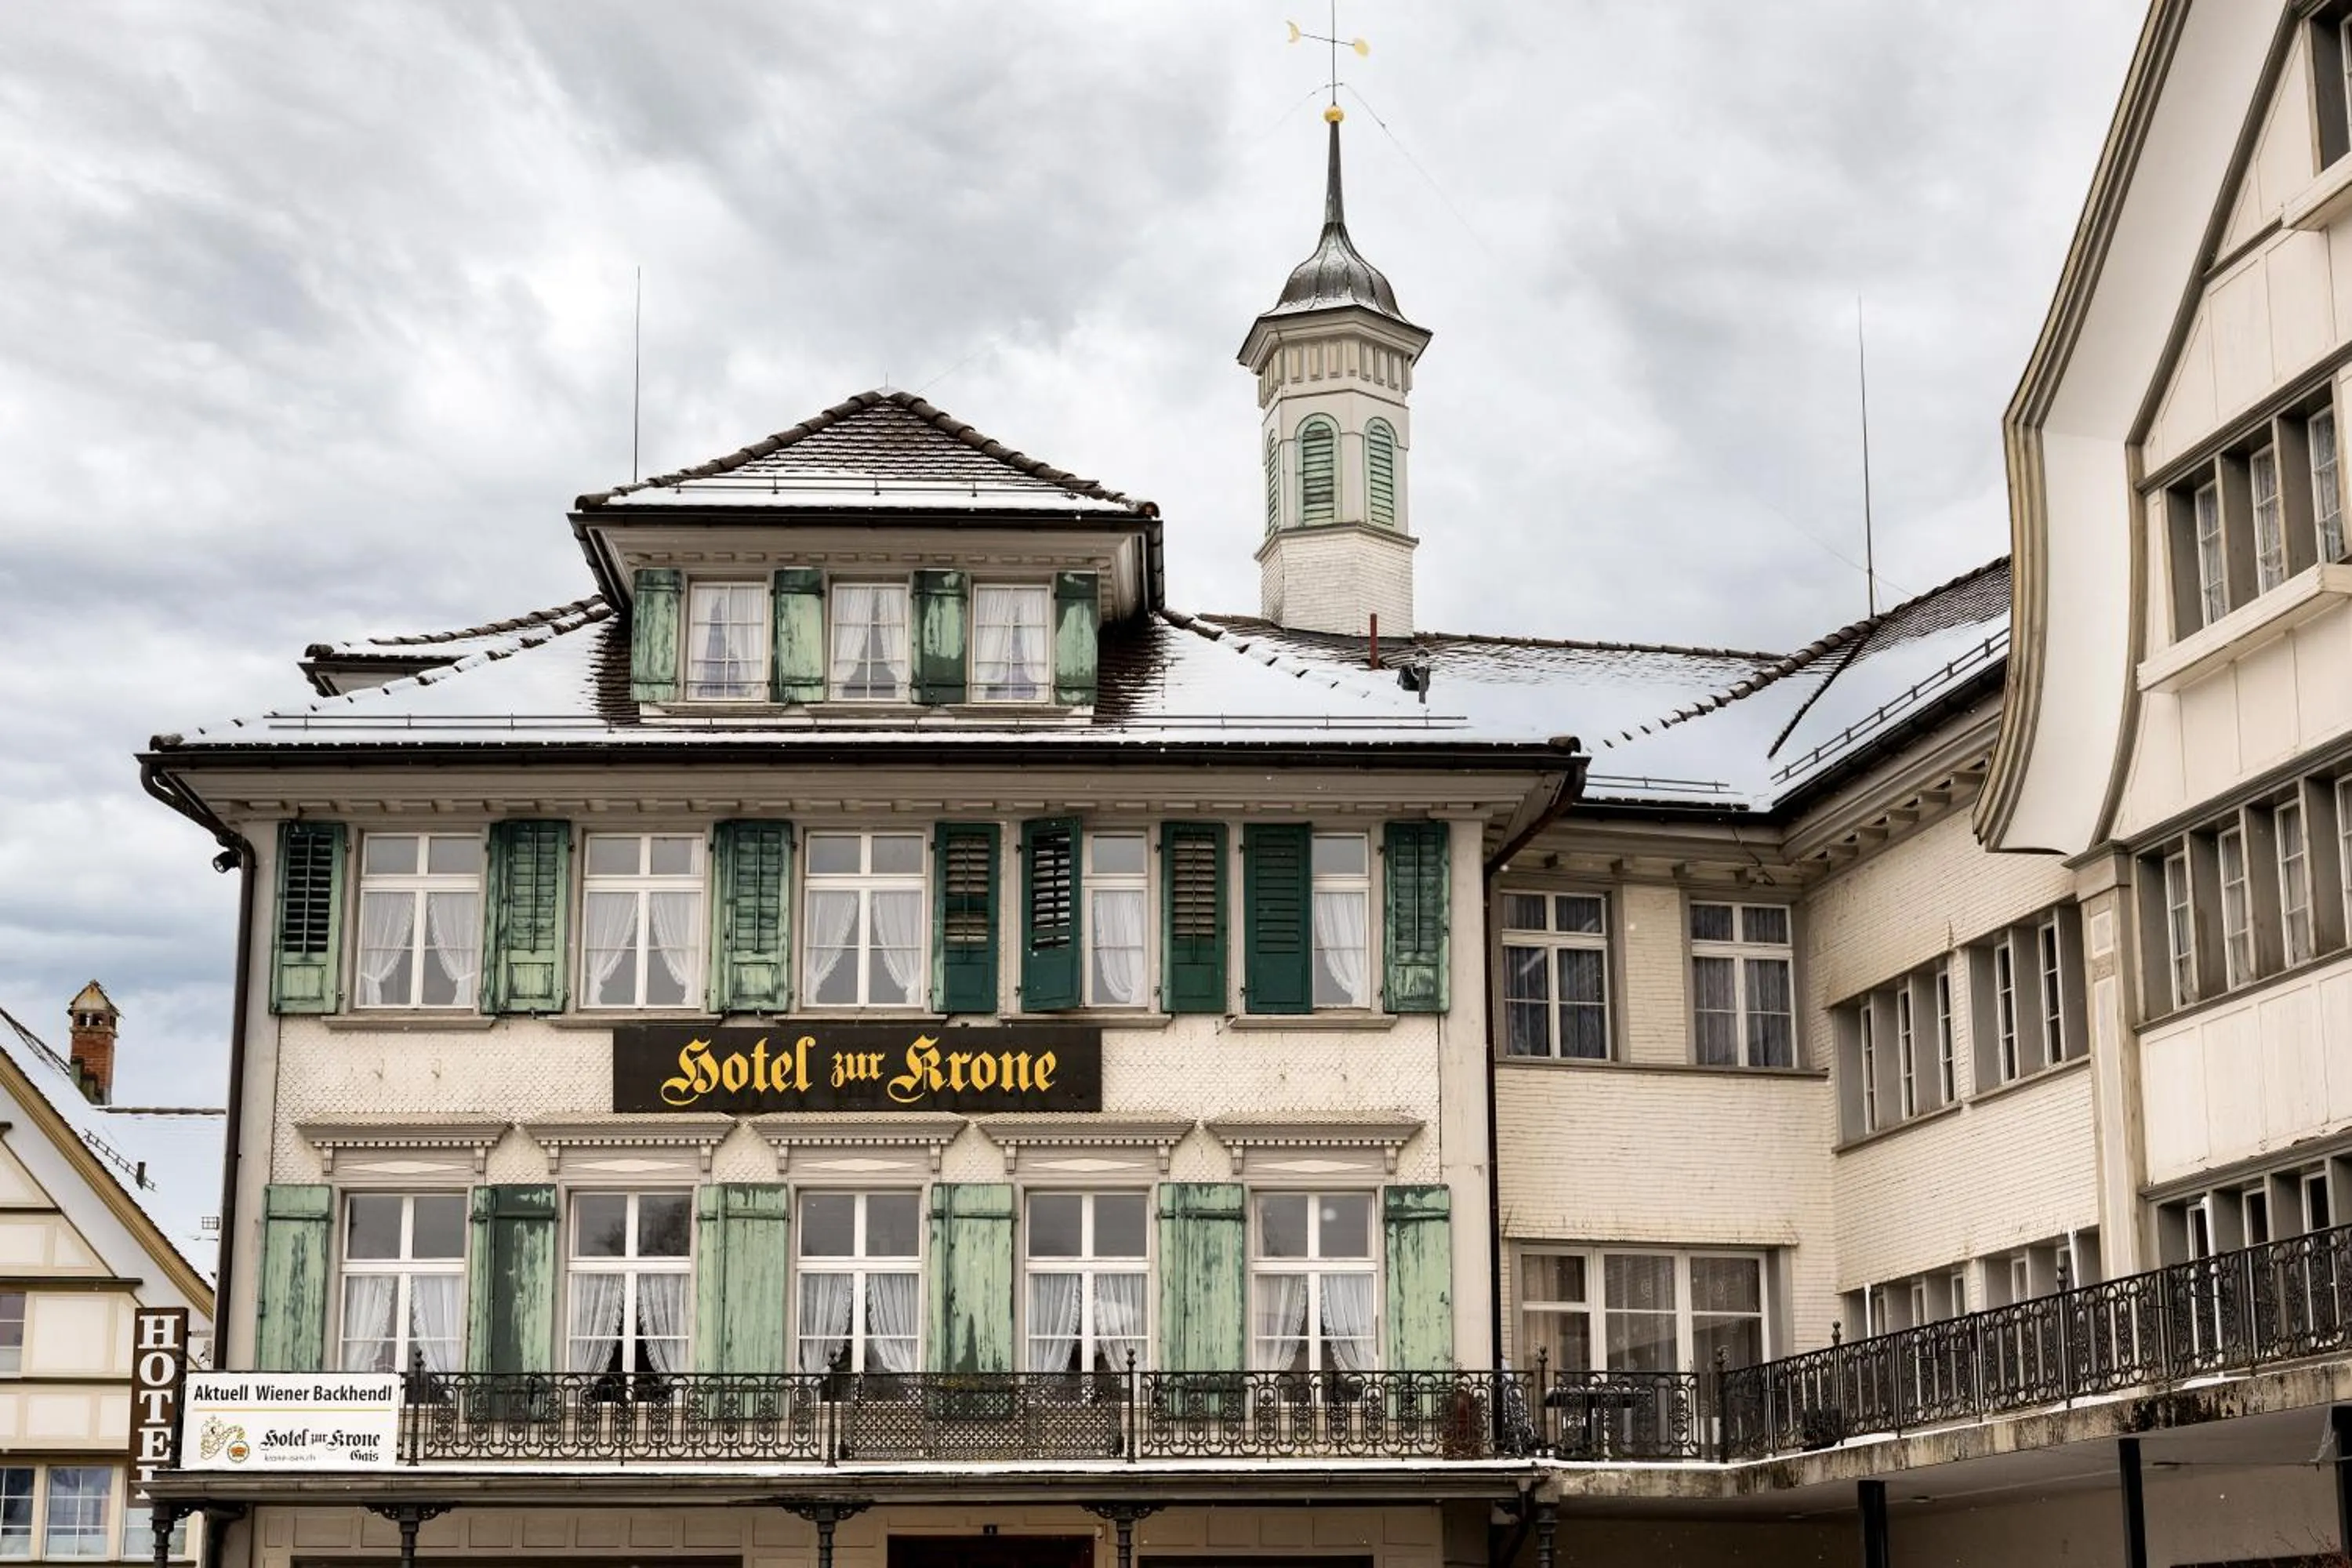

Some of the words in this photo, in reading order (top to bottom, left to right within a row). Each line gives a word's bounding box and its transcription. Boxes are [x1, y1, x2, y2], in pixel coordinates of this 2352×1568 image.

[662, 1036, 815, 1105] Hotel
[830, 1051, 886, 1087] zur
[887, 1034, 1057, 1103] Krone
[194, 1385, 249, 1402] Aktuell
[256, 1385, 310, 1402] Wiener
[314, 1385, 392, 1402] Backhendl
[260, 1428, 309, 1451] Hotel
[326, 1429, 380, 1451] Krone
[350, 1450, 379, 1462] Gais
